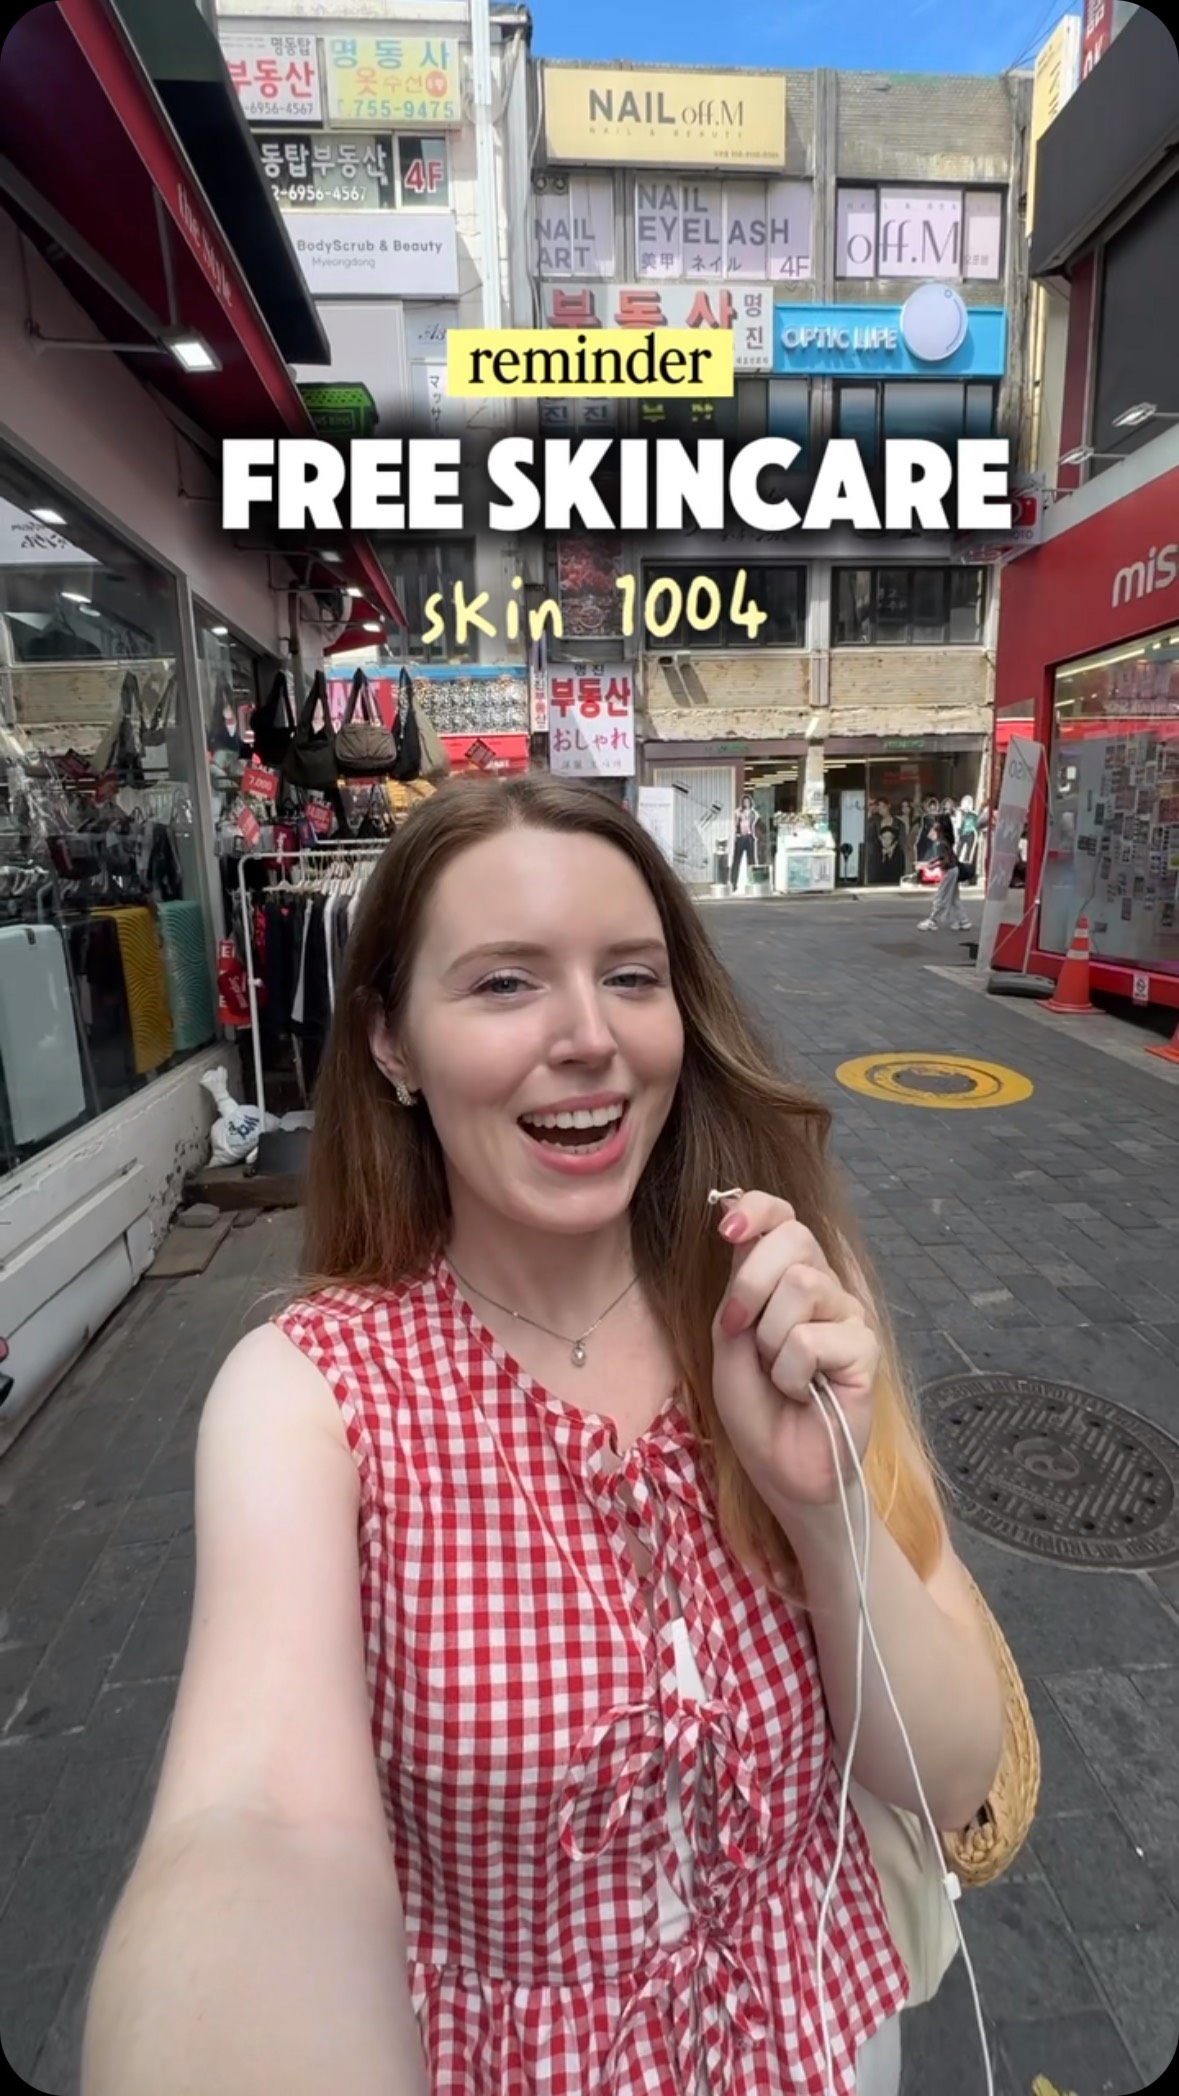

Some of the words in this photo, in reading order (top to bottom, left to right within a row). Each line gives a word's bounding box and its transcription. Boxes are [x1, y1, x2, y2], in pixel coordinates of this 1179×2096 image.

[589, 89, 676, 124] NAIL
[681, 100, 744, 126] off.M
[404, 160, 444, 193] 4F
[638, 184, 708, 213] NAIL
[535, 219, 595, 240] NAIL
[638, 217, 789, 245] EYELASH
[299, 240, 375, 254] BodyScrub
[379, 240, 388, 251] &
[393, 240, 443, 255] Beauty
[846, 219, 960, 264] off.M
[536, 247, 591, 268] ART
[641, 253, 675, 270] 美甲
[691, 255, 742, 272] ネイル
[780, 256, 809, 277] 4F
[781, 326, 849, 349] OPTIC
[551, 678, 631, 718] 부동산
[553, 728, 630, 752] おしゃれ
